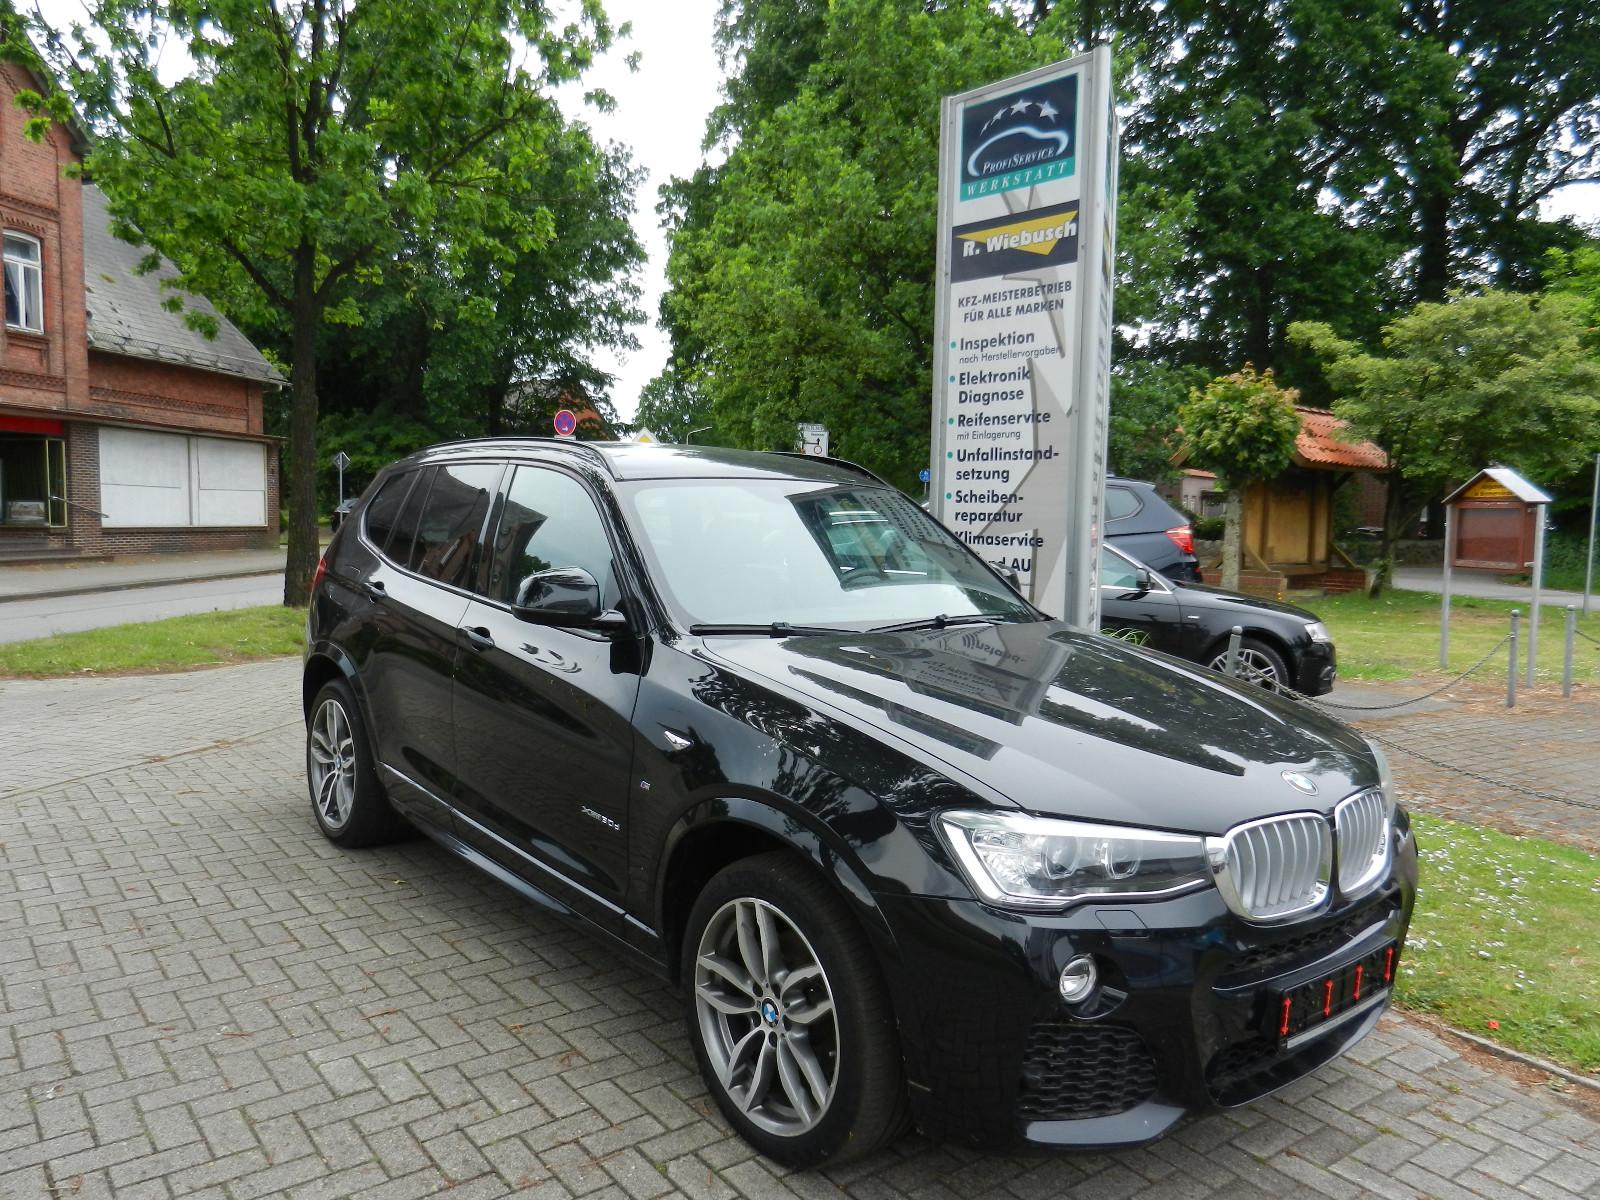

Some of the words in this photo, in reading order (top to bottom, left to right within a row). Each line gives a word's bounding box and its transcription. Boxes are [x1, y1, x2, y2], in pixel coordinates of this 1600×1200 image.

[967, 162, 1067, 195] WERKSTATT
[962, 240, 980, 257] R.
[986, 221, 1077, 252] Wiebusch
[958, 280, 1071, 308] KFZ-MEISTERBETRIEB
[964, 308, 984, 323] FÜR
[987, 306, 1012, 319] ALLE
[1015, 299, 1064, 315] MARKEN
[960, 331, 1035, 351] Inspektion
[959, 354, 979, 364] nach
[959, 366, 1031, 386] Elektronik
[958, 389, 1025, 406] Diagnose
[957, 409, 1051, 428] Reifenservice
[956, 431, 970, 441] mit
[972, 430, 1021, 442] Einlagerung
[956, 445, 1060, 463] Unfallinstand-
[956, 468, 1010, 483] setzung
[955, 490, 1024, 504] Scheiben-
[954, 510, 1023, 525] reparatur
[1011, 558, 1031, 572] AU
